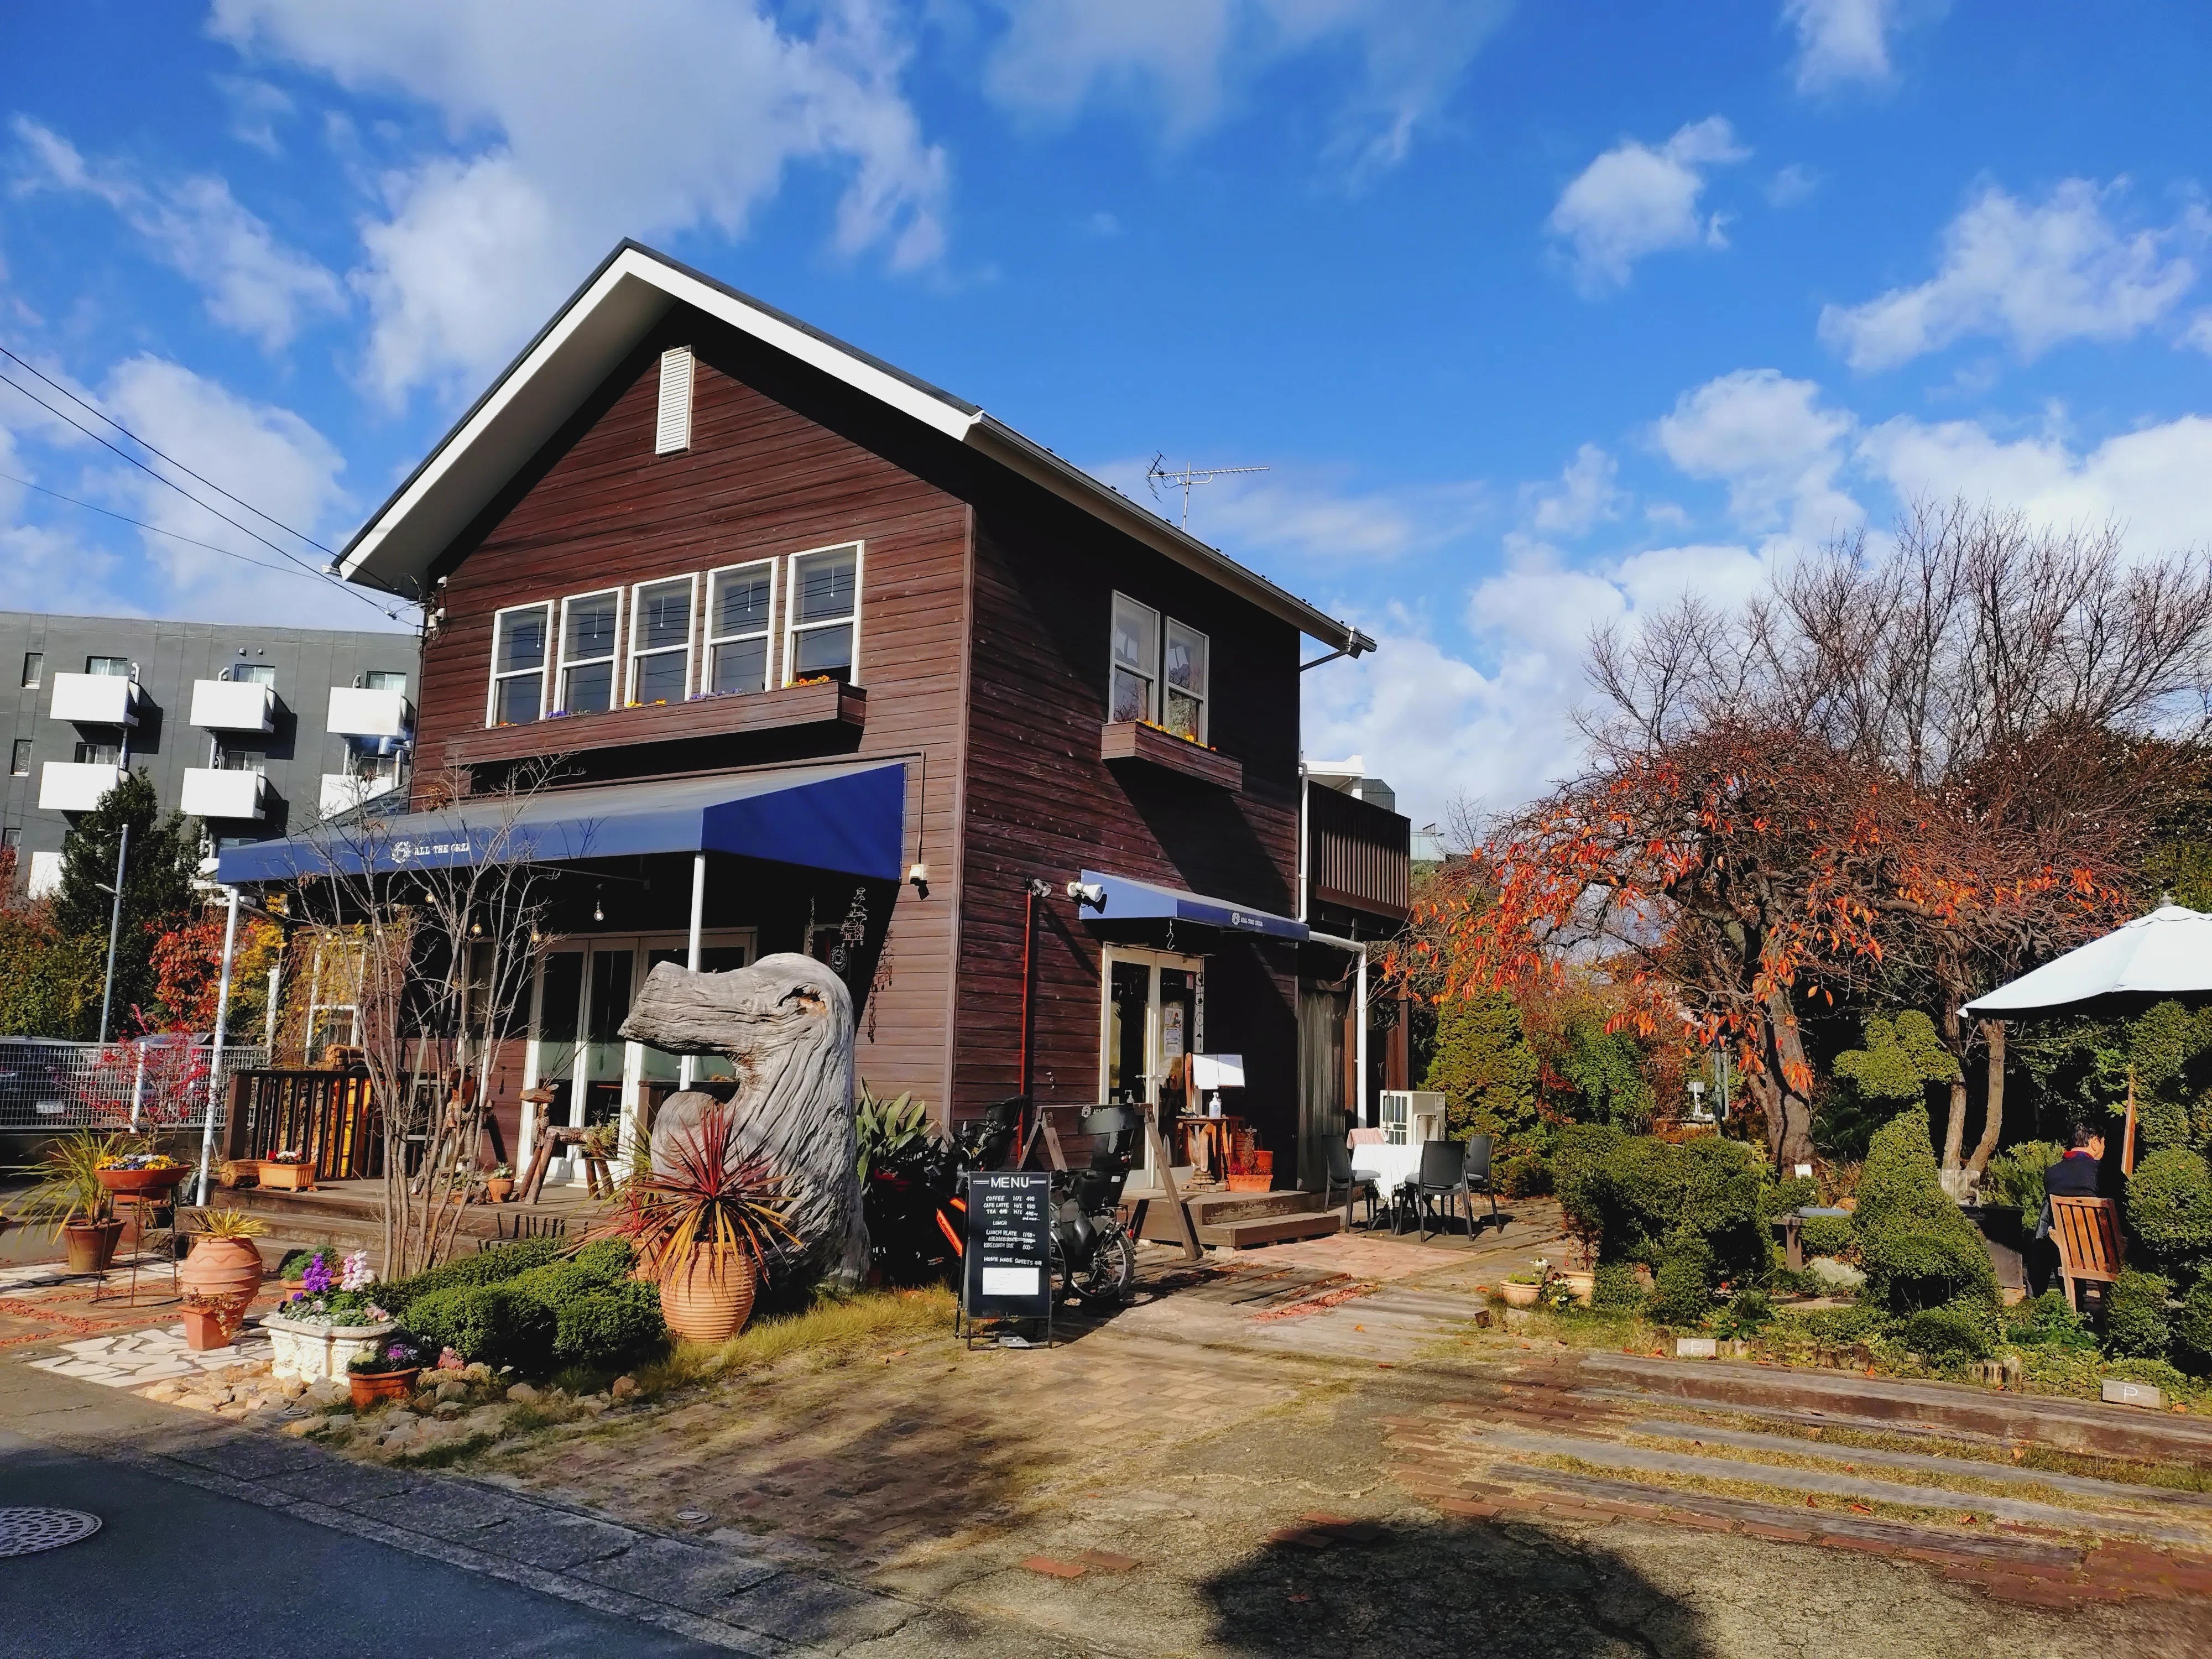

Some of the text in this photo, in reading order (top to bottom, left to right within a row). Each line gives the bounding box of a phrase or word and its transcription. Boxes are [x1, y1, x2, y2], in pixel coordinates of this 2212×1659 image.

[414, 846, 430, 855] ALL
[433, 844, 448, 854] THE
[991, 1177, 1029, 1188] MENU
[1014, 1258, 1034, 1266] SWEETS
[1691, 1341, 1703, 1356] P
[2123, 1386, 2138, 1401] P
